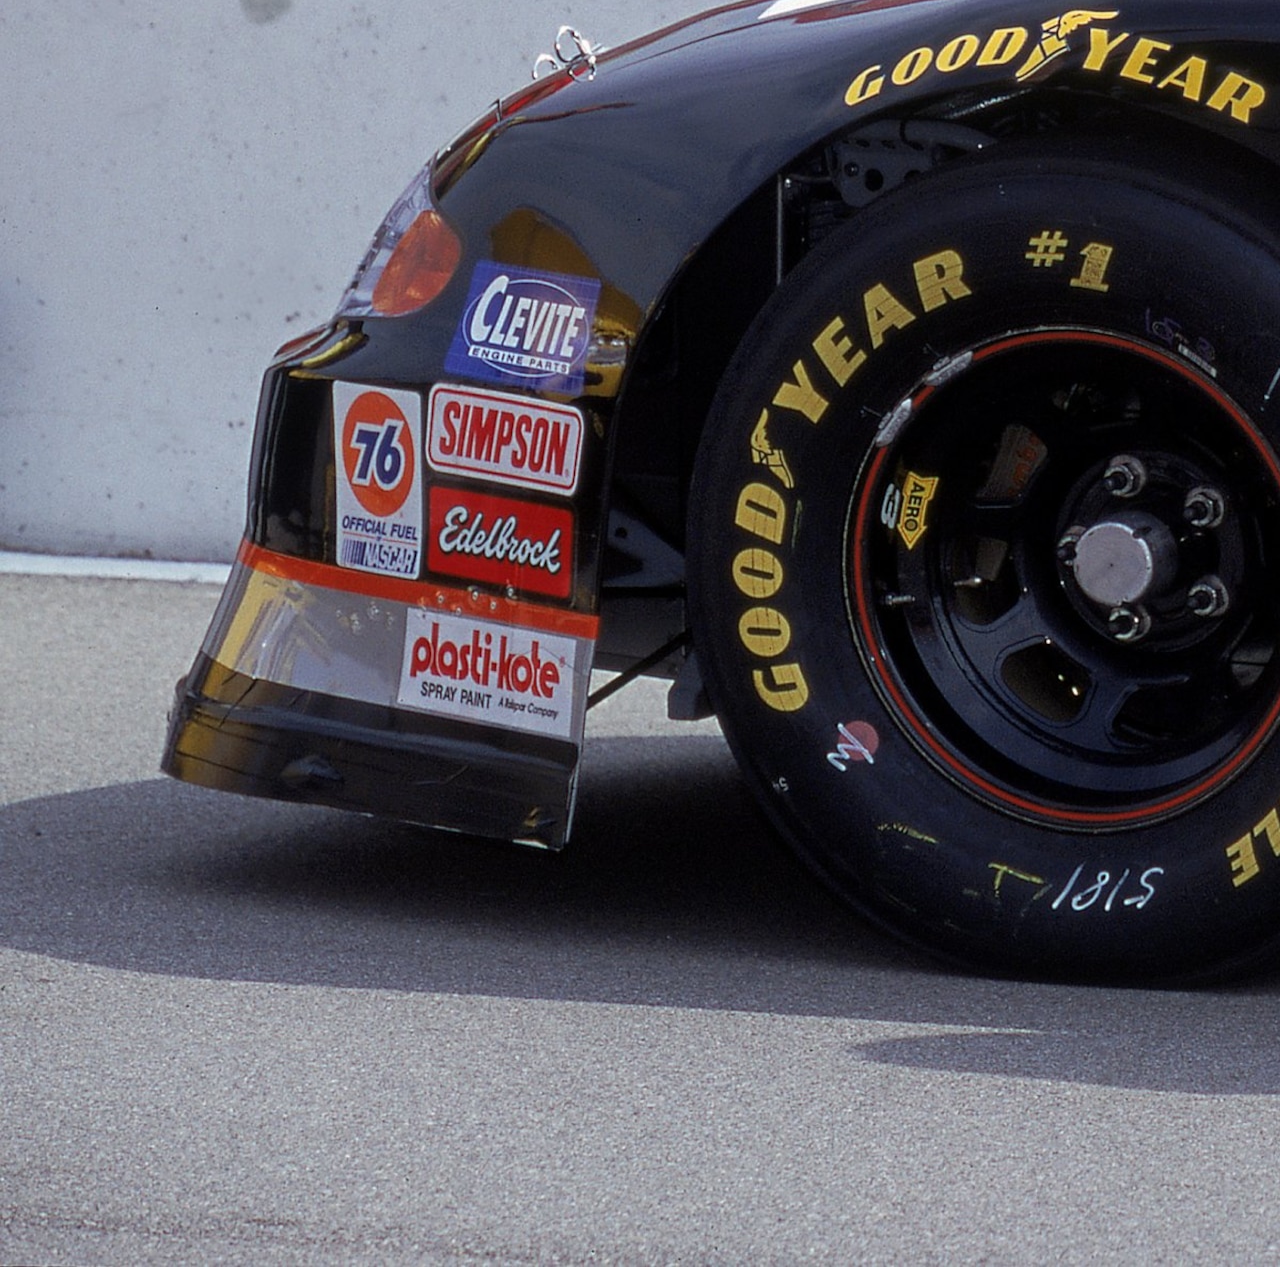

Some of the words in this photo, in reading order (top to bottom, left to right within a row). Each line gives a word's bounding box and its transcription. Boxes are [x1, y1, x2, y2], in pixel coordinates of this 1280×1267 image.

[1024, 228, 1115, 294] #1
[470, 275, 586, 358] CLEVITE
[471, 347, 523, 365] ENGINE
[530, 357, 569, 374] PARTS
[352, 419, 405, 489] 76
[439, 401, 571, 477] SIMPSON
[341, 514, 388, 536] OFFICIAL
[390, 521, 418, 541] FUEL
[438, 505, 561, 573] Edelbrock
[904, 481, 926, 532] AERO
[364, 540, 418, 574] NASCAR
[410, 622, 560, 699] plasti-kote
[421, 680, 458, 702] SPRAY
[460, 689, 492, 709] PAINT
[527, 702, 559, 720] Company
